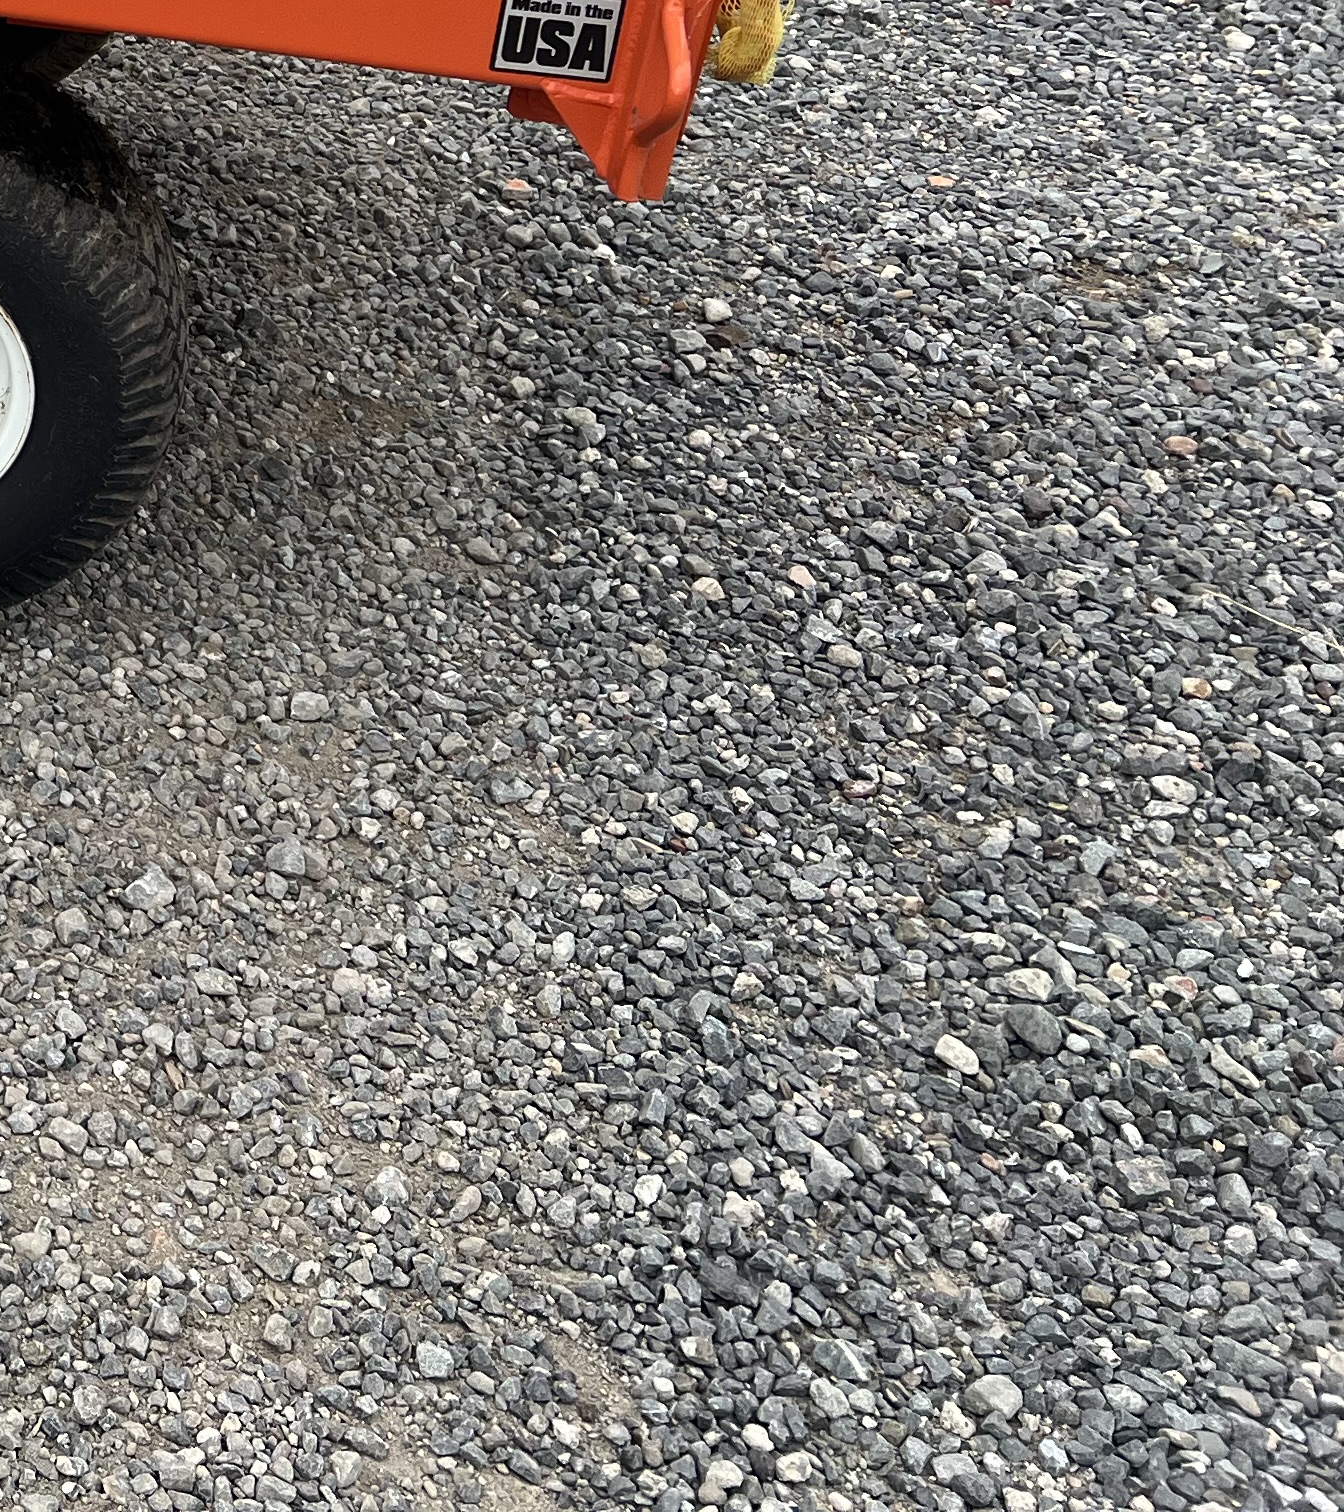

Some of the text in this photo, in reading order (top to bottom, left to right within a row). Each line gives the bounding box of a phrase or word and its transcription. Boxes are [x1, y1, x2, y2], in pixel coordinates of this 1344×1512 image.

[565, 1, 581, 17] in
[585, 3, 614, 20] the
[501, 15, 607, 73] USA
